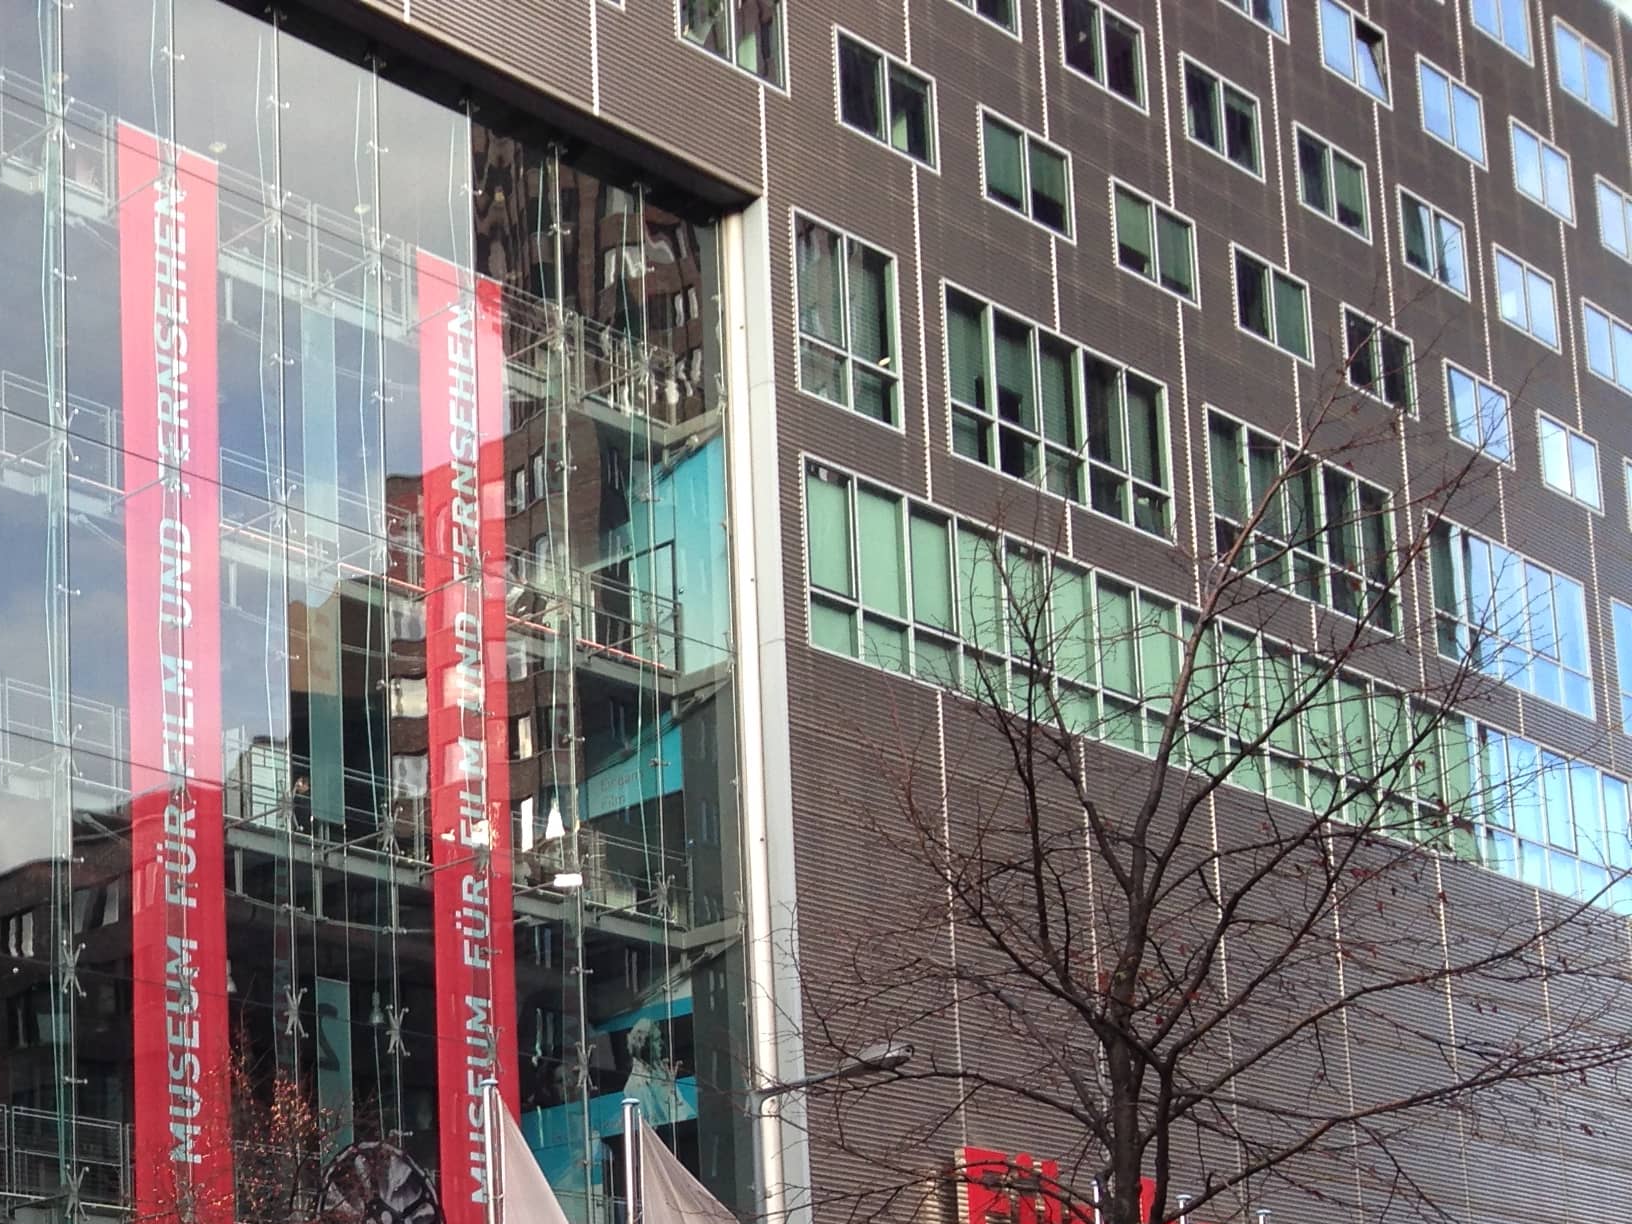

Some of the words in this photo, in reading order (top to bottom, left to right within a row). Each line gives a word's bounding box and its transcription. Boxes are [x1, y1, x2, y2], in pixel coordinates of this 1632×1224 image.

[159, 517, 193, 628] UND
[156, 798, 197, 909] FÜR
[456, 874, 490, 969] FÜR
[169, 939, 202, 1164] MUSEUM
